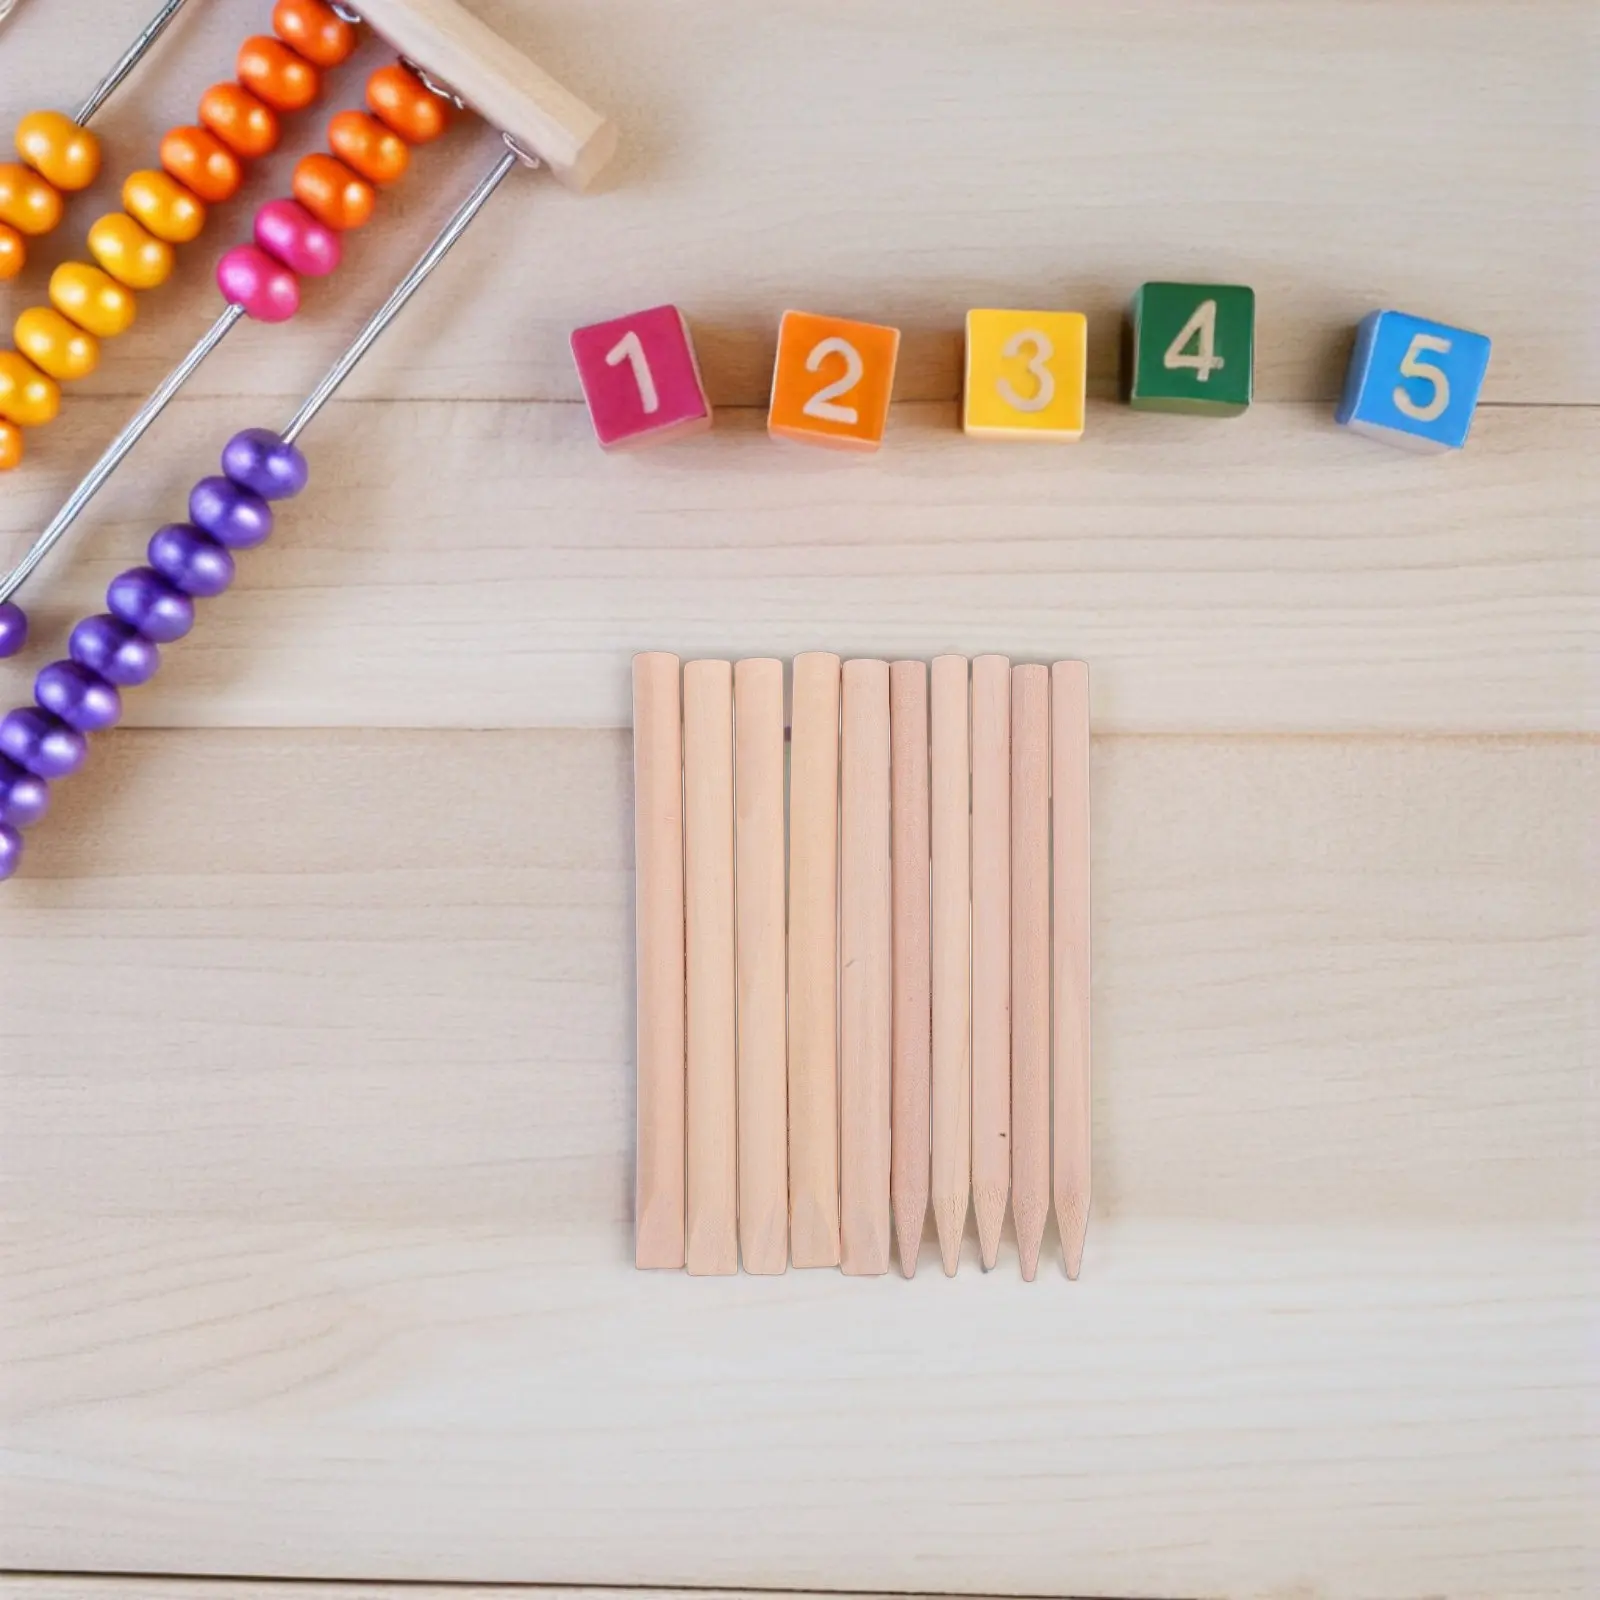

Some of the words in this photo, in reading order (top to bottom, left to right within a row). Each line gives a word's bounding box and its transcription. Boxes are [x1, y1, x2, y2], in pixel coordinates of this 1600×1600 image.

[605, 331, 659, 414] 1
[802, 337, 863, 425] 2
[995, 330, 1055, 413] 3
[1163, 299, 1225, 382] 4
[1392, 333, 1452, 422] 5
